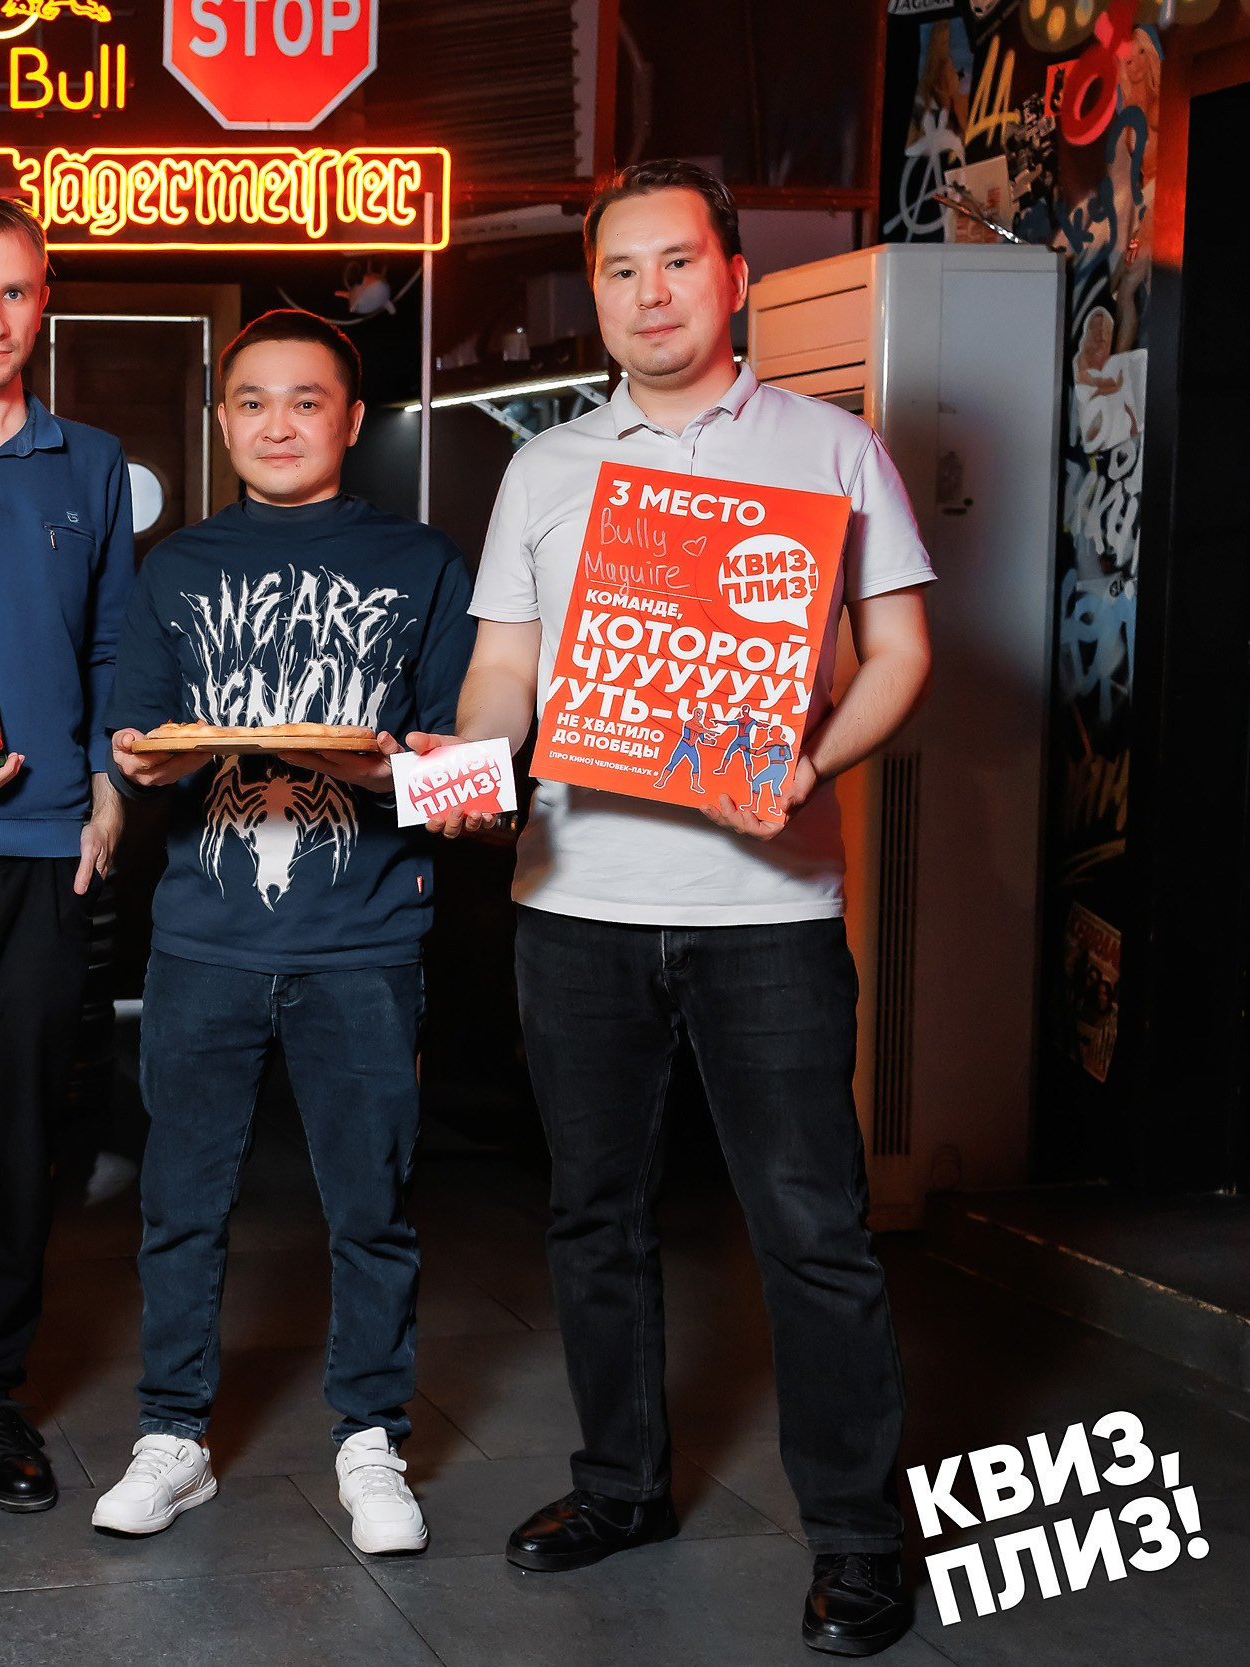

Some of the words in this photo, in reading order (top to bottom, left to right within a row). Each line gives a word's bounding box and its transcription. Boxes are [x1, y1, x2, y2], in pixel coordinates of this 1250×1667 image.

[189, 0, 361, 57] STOP
[10, 43, 126, 110] Bull
[609, 480, 631, 506] 3
[639, 484, 767, 527] МЕСТО
[599, 507, 667, 558] Bully
[584, 550, 691, 596] Maguire
[721, 548, 817, 580] КВИЗ,
[585, 588, 684, 620] КОМАНДЕ,
[719, 574, 818, 605] ПЛИЗ!
[576, 609, 811, 679] КОТОРОЙ
[552, 729, 581, 745] ДО
[583, 734, 660, 759] ПОБЕДЫ
[556, 712, 580, 727] НЕ
[582, 717, 665, 743] ХВАТИЛО
[594, 760, 652, 776] ЧЕЛОВЕК-ПАУК
[414, 767, 501, 822] ПЛИЗ!
